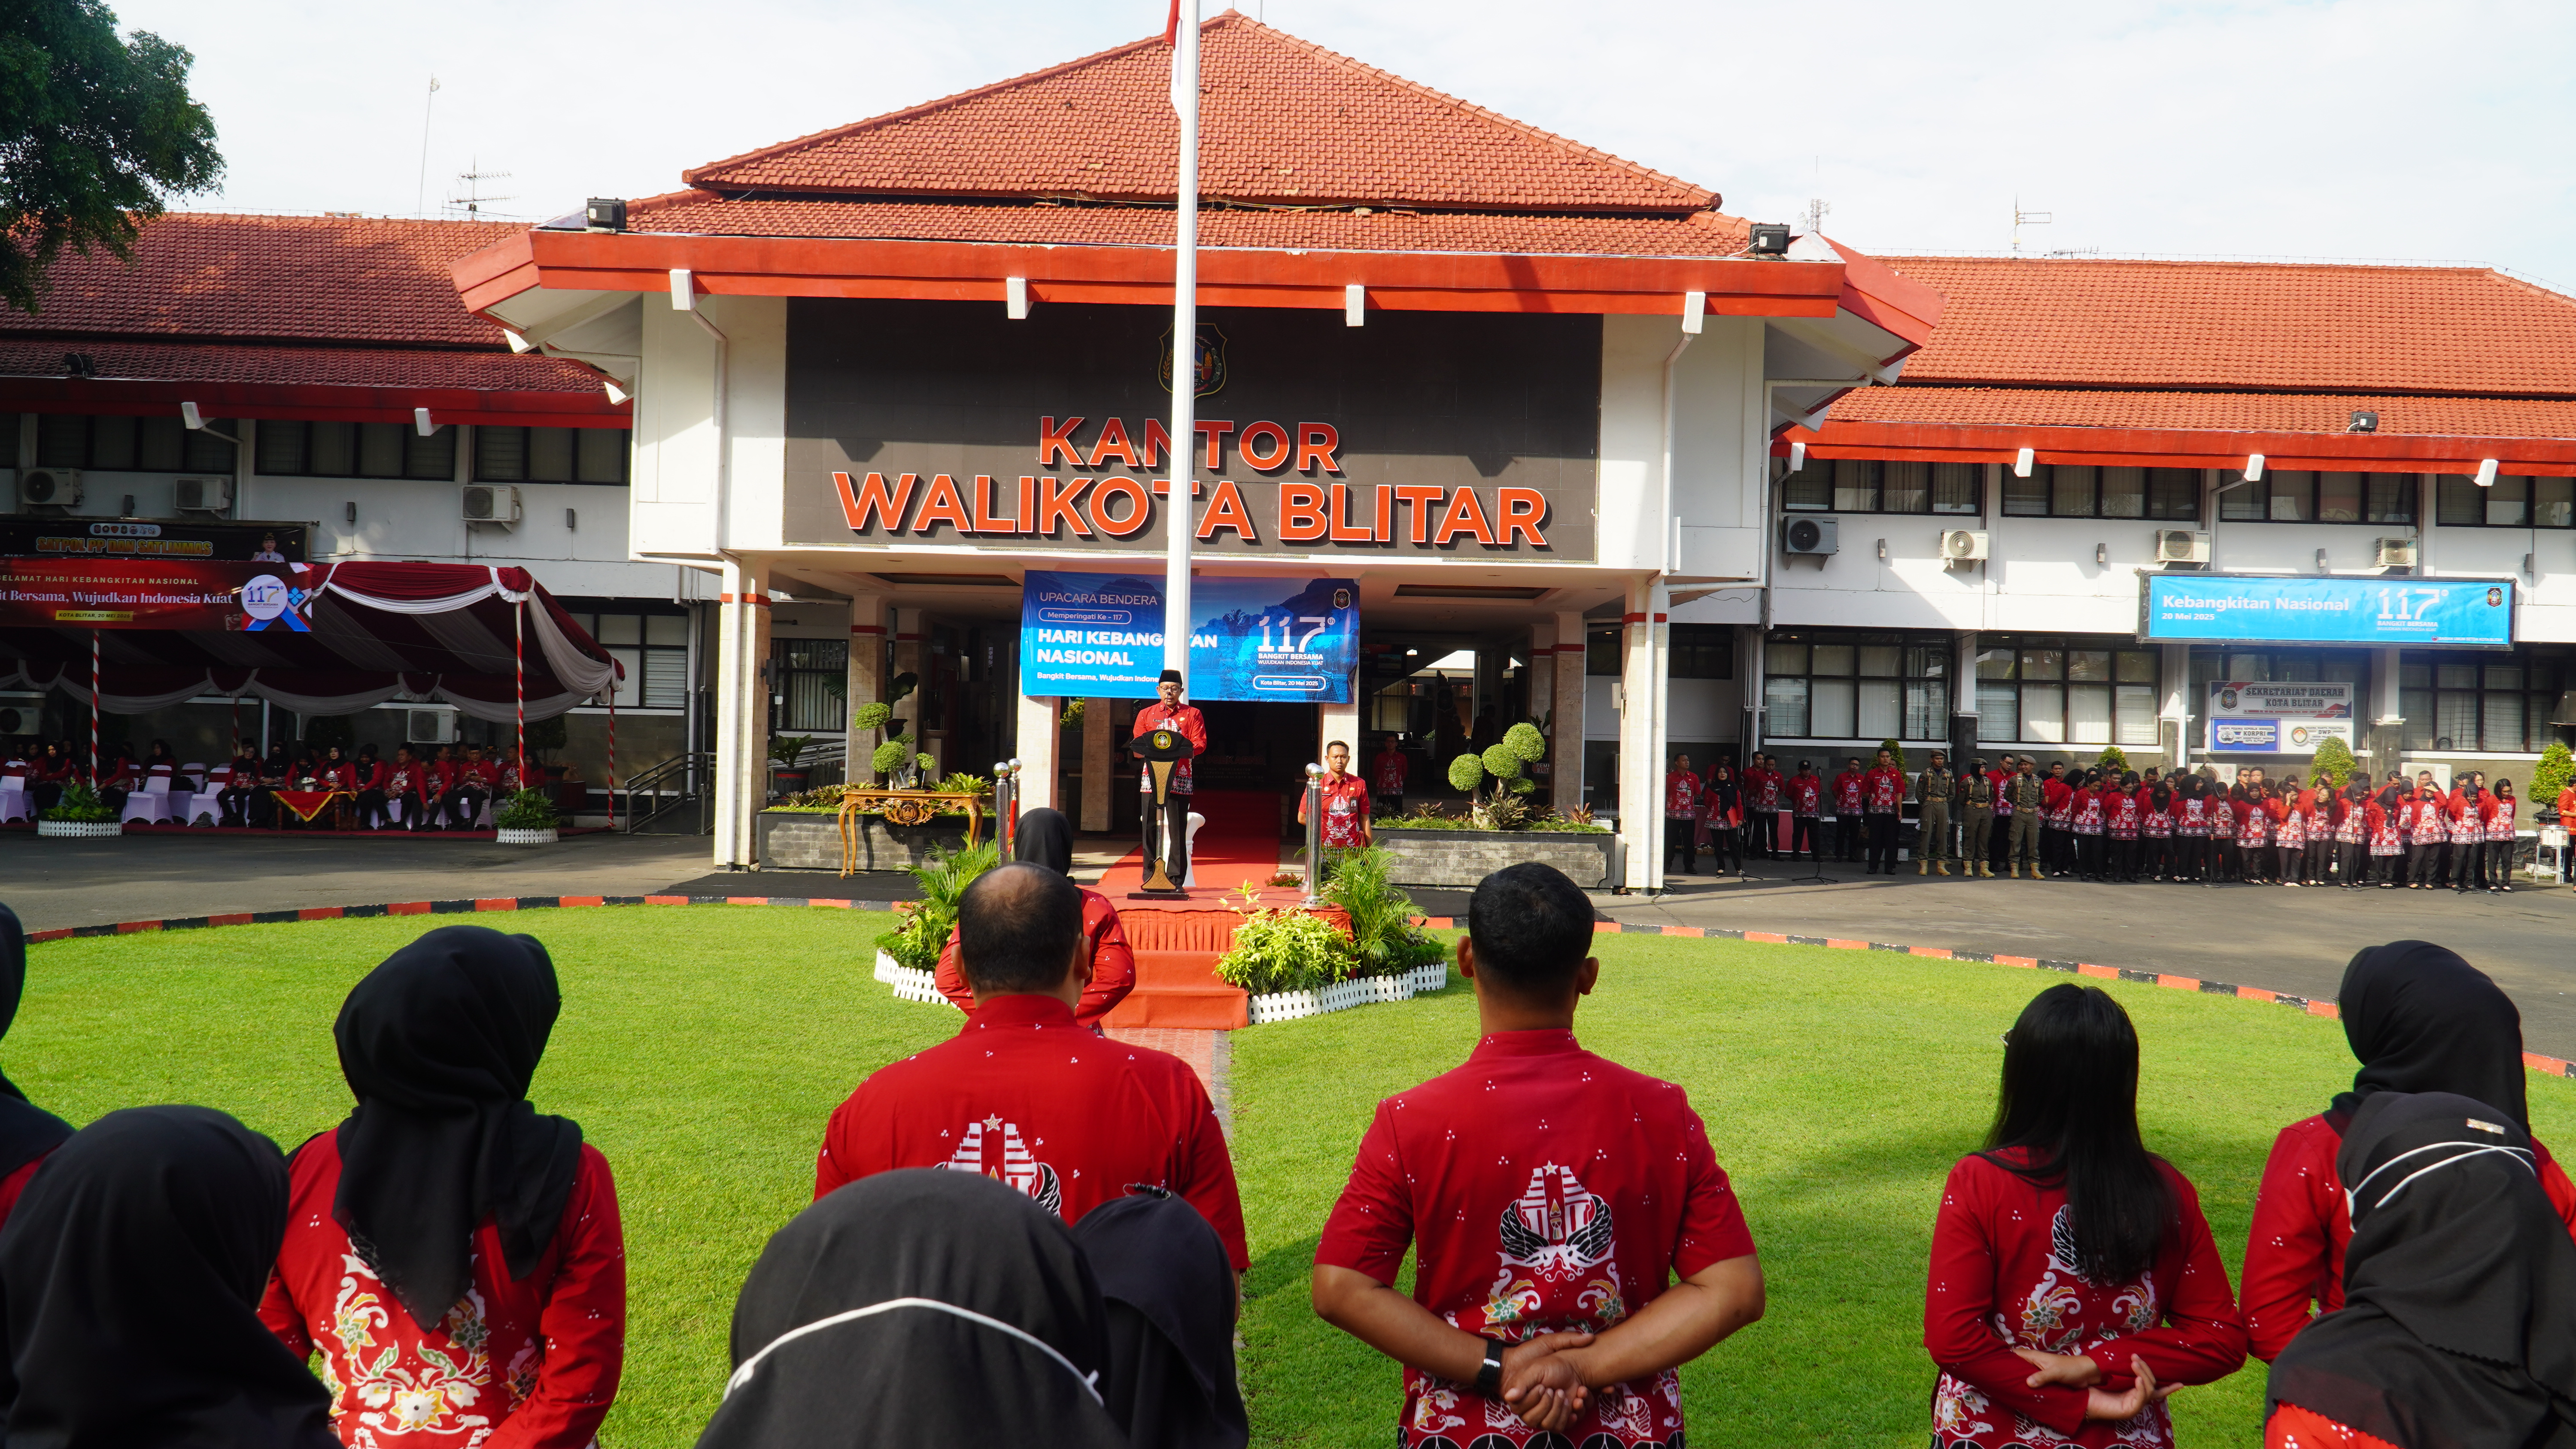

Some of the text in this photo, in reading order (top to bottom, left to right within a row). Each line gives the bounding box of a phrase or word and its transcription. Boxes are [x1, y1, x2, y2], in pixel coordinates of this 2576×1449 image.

[1039, 415, 1340, 471] KANTOR
[1278, 482, 1547, 546] BLITAR
[37, 537, 213, 556] SATPOL PP DAN SATLINMAS
[10, 590, 69, 603] Bersama,
[73, 591, 137, 605] Wujudkan
[140, 593, 200, 603] Indonesia
[203, 594, 233, 603] Kuat
[248, 586, 279, 602] 117
[1040, 592, 1157, 605] UPACARA BENDERA
[2163, 595, 2349, 612] Kebangkitan Nasional
[2378, 588, 2439, 620] 117
[1048, 612, 1096, 620] Memperingati
[1038, 628, 1218, 648] HARI KEBANGAN
[1258, 616, 1325, 652] 117
[1037, 649, 1133, 666] NASIONAL
[1037, 672, 1064, 680] Bangkit
[1065, 673, 1098, 681] Bersama,
[1100, 674, 1133, 682] Wujudkan
[2246, 688, 2344, 696] SEKRETARIAT DAERAH
[2266, 698, 2323, 707] KOTA BLITAR
